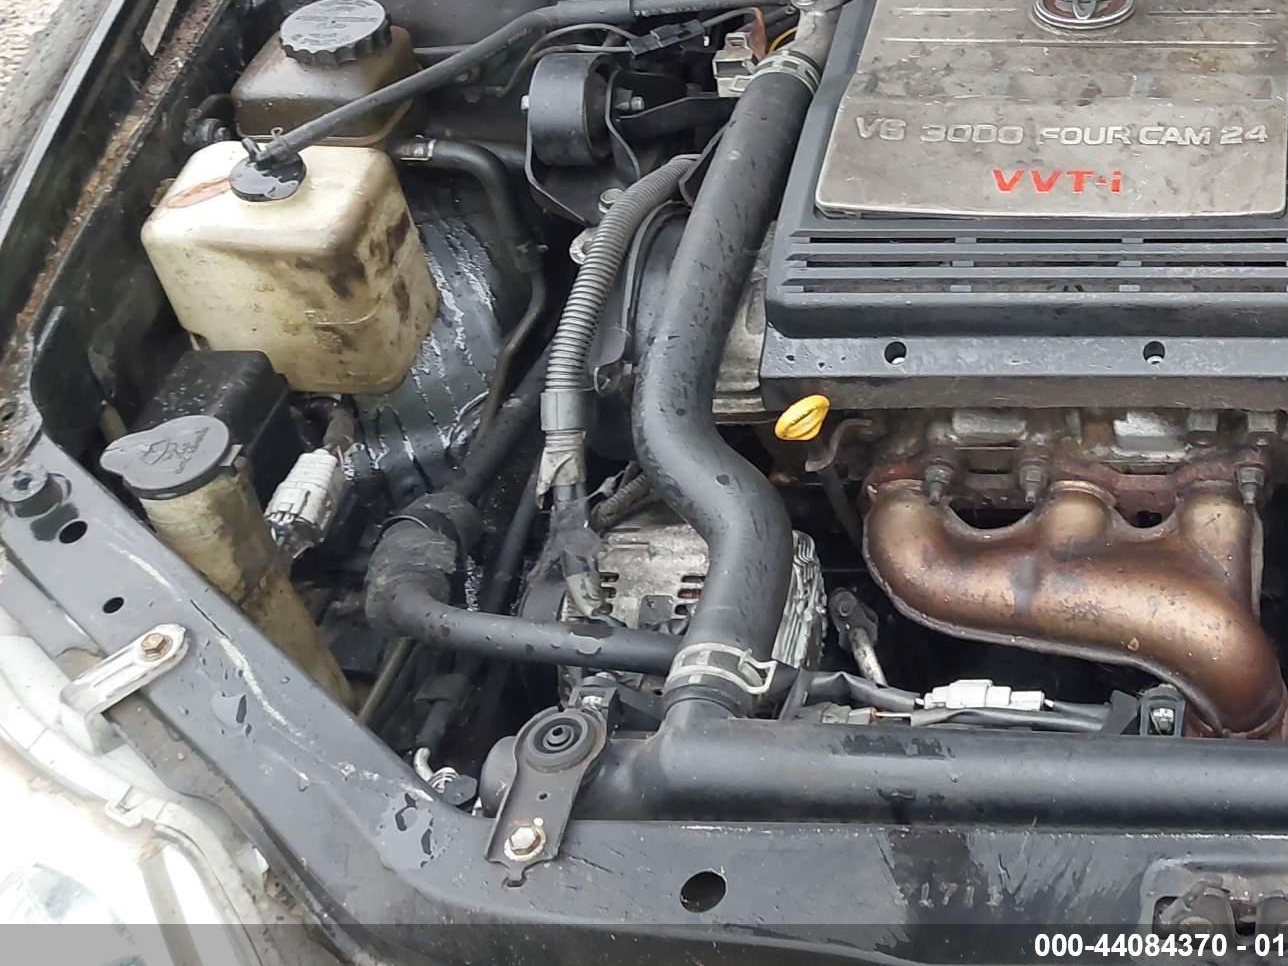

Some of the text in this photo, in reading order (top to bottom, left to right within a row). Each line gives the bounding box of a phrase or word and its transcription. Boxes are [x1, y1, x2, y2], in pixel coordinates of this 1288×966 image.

[856, 117, 1268, 146] V6 3000 FOUR CAM 24
[992, 168, 1122, 194] VVT-i
